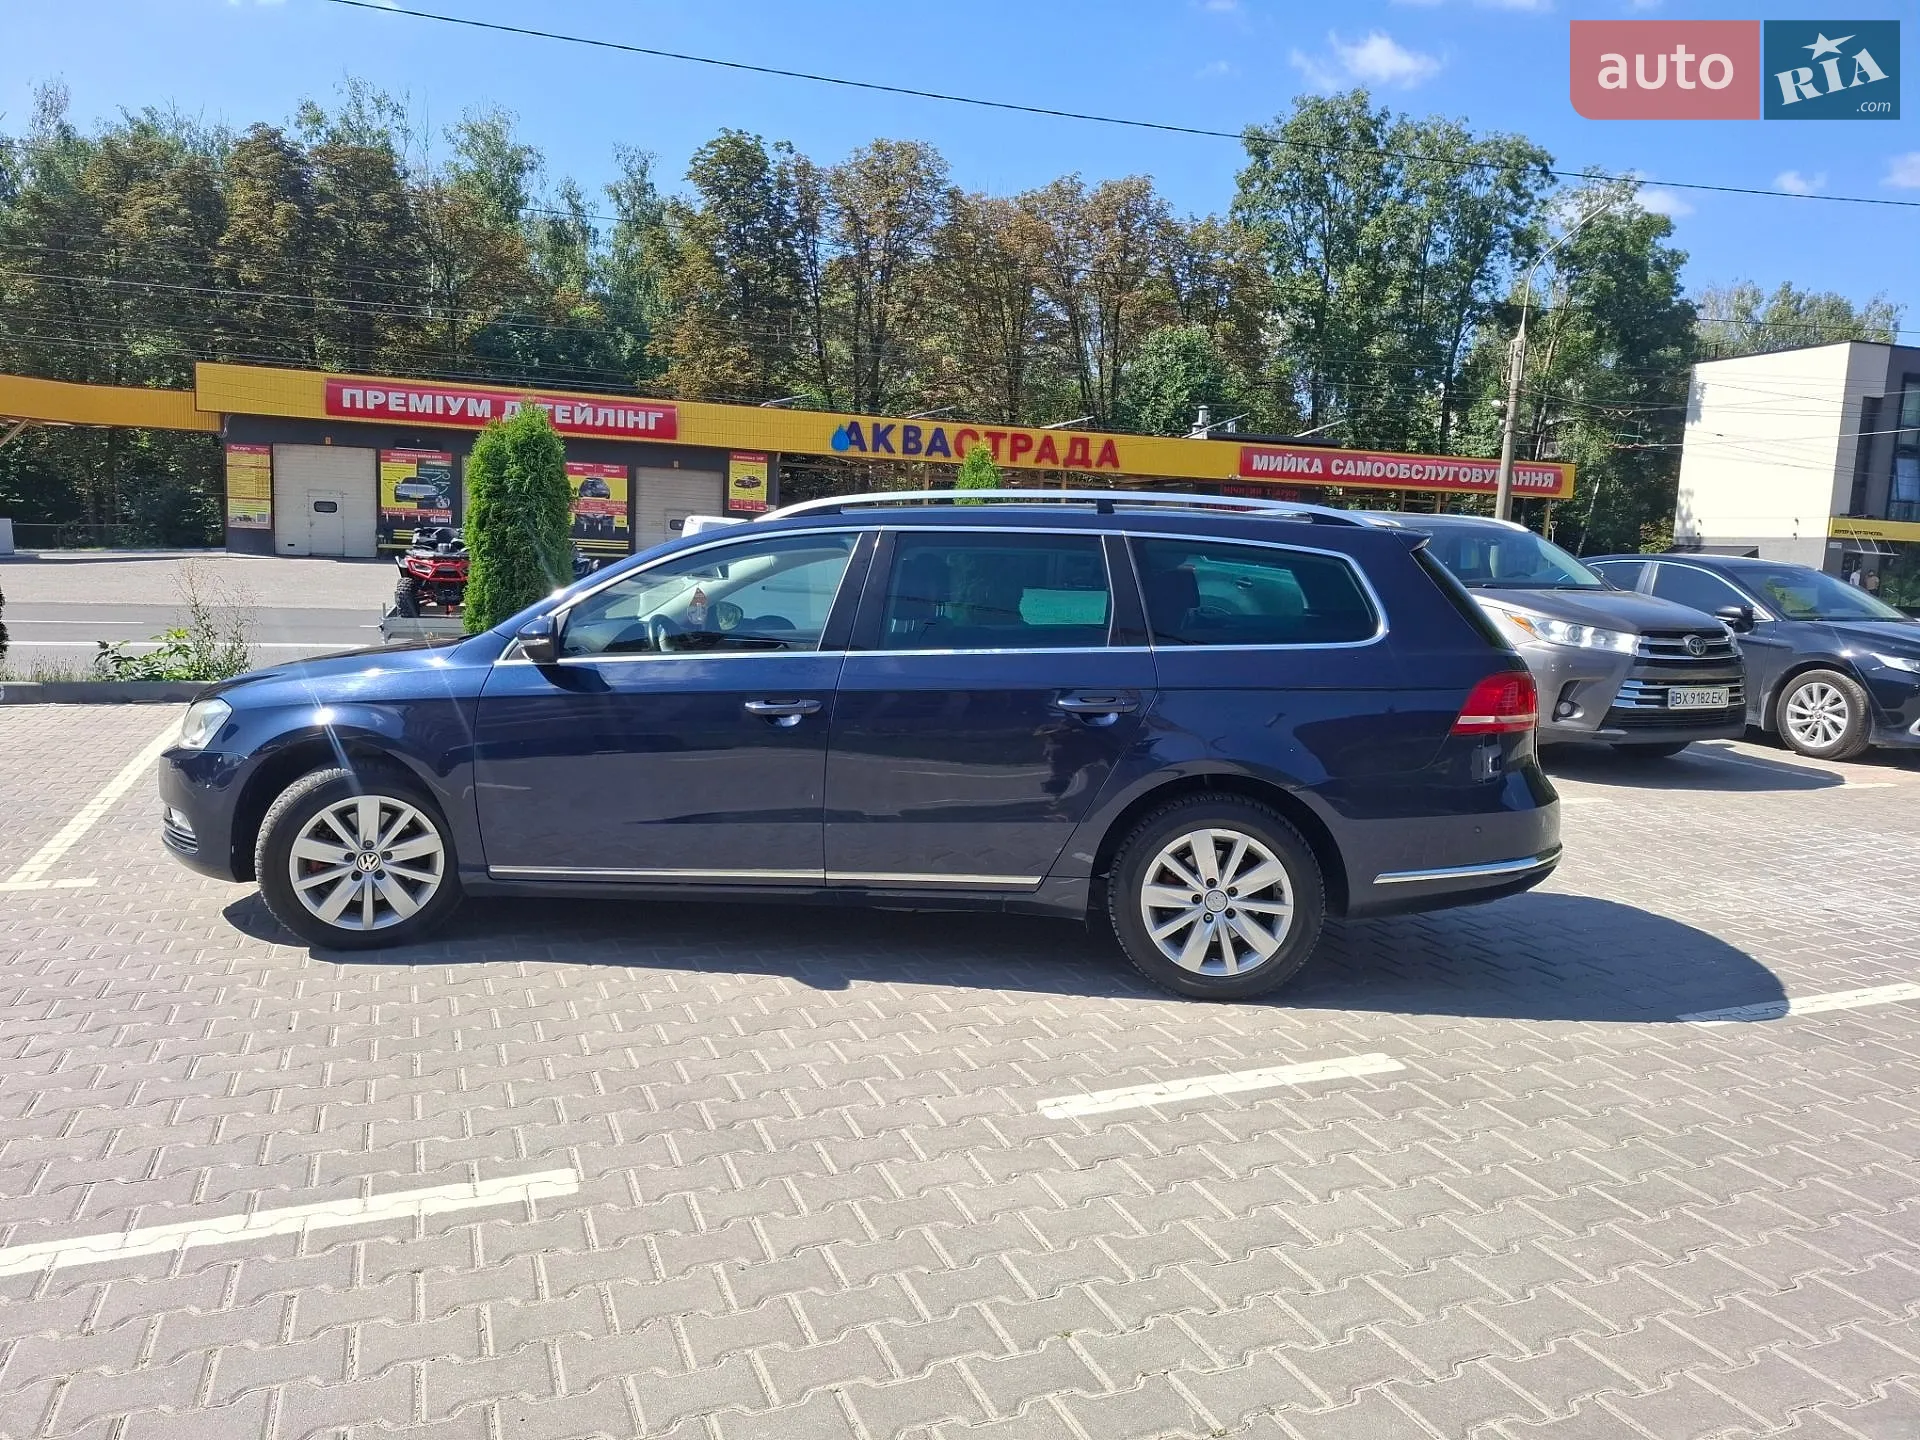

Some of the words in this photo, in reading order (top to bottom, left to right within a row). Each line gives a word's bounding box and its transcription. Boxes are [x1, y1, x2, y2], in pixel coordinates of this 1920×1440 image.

[341, 388, 491, 418] ПРЕМІУМ
[502, 400, 664, 430] ДЕЙЛІНГ
[846, 420, 1121, 469] АКВАСТРАДА
[1252, 452, 1323, 475] МИЙКА
[1675, 692, 1688, 705] BX
[1690, 692, 1711, 704] 9182
